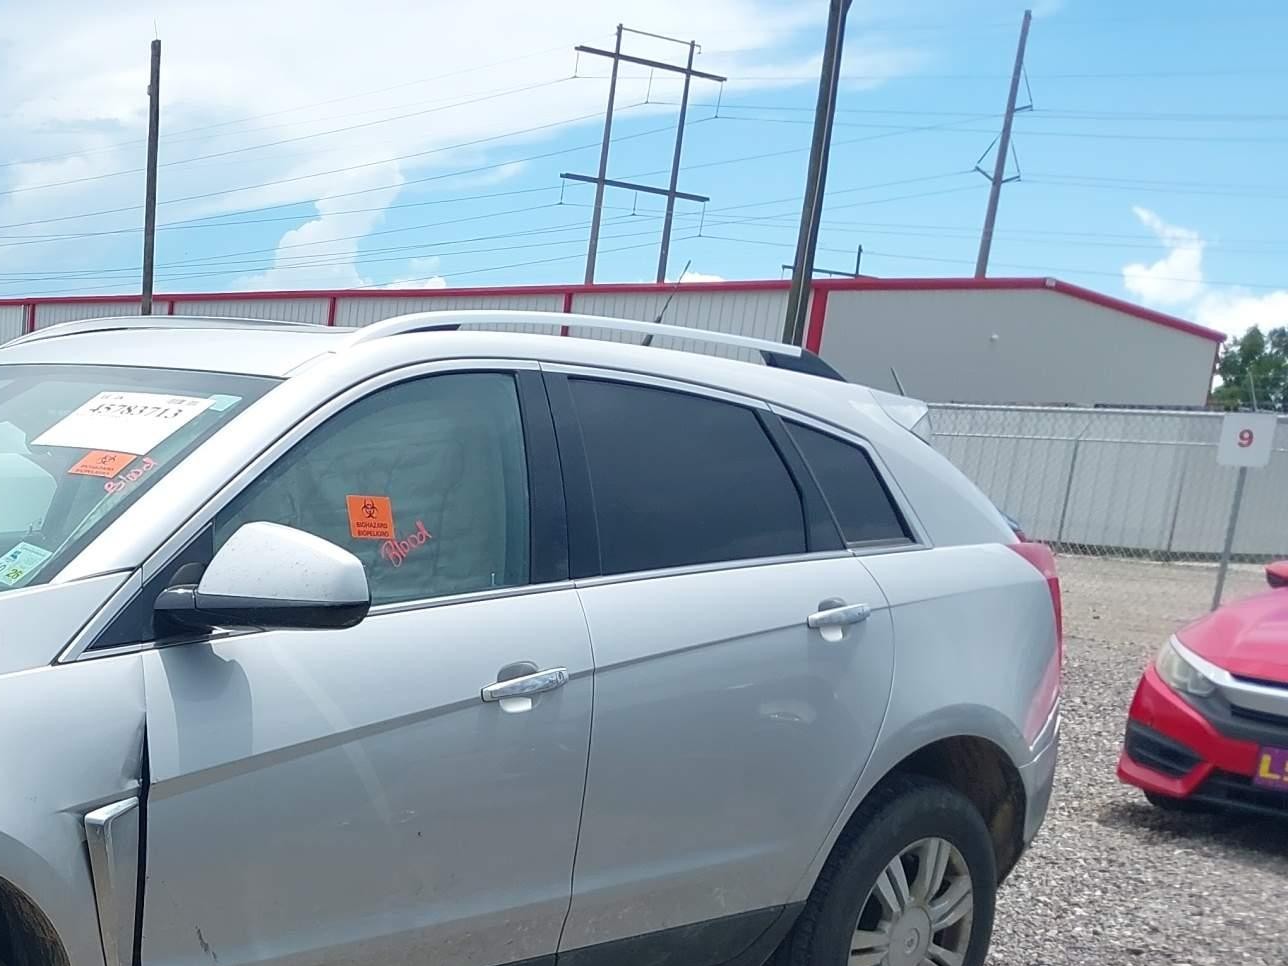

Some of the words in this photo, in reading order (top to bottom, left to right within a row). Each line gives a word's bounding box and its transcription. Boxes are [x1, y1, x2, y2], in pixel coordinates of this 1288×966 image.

[89, 402, 184, 419] 45783713
[1237, 429, 1254, 448] 9
[381, 520, 432, 568] Blood
[1258, 753, 1288, 783] L
